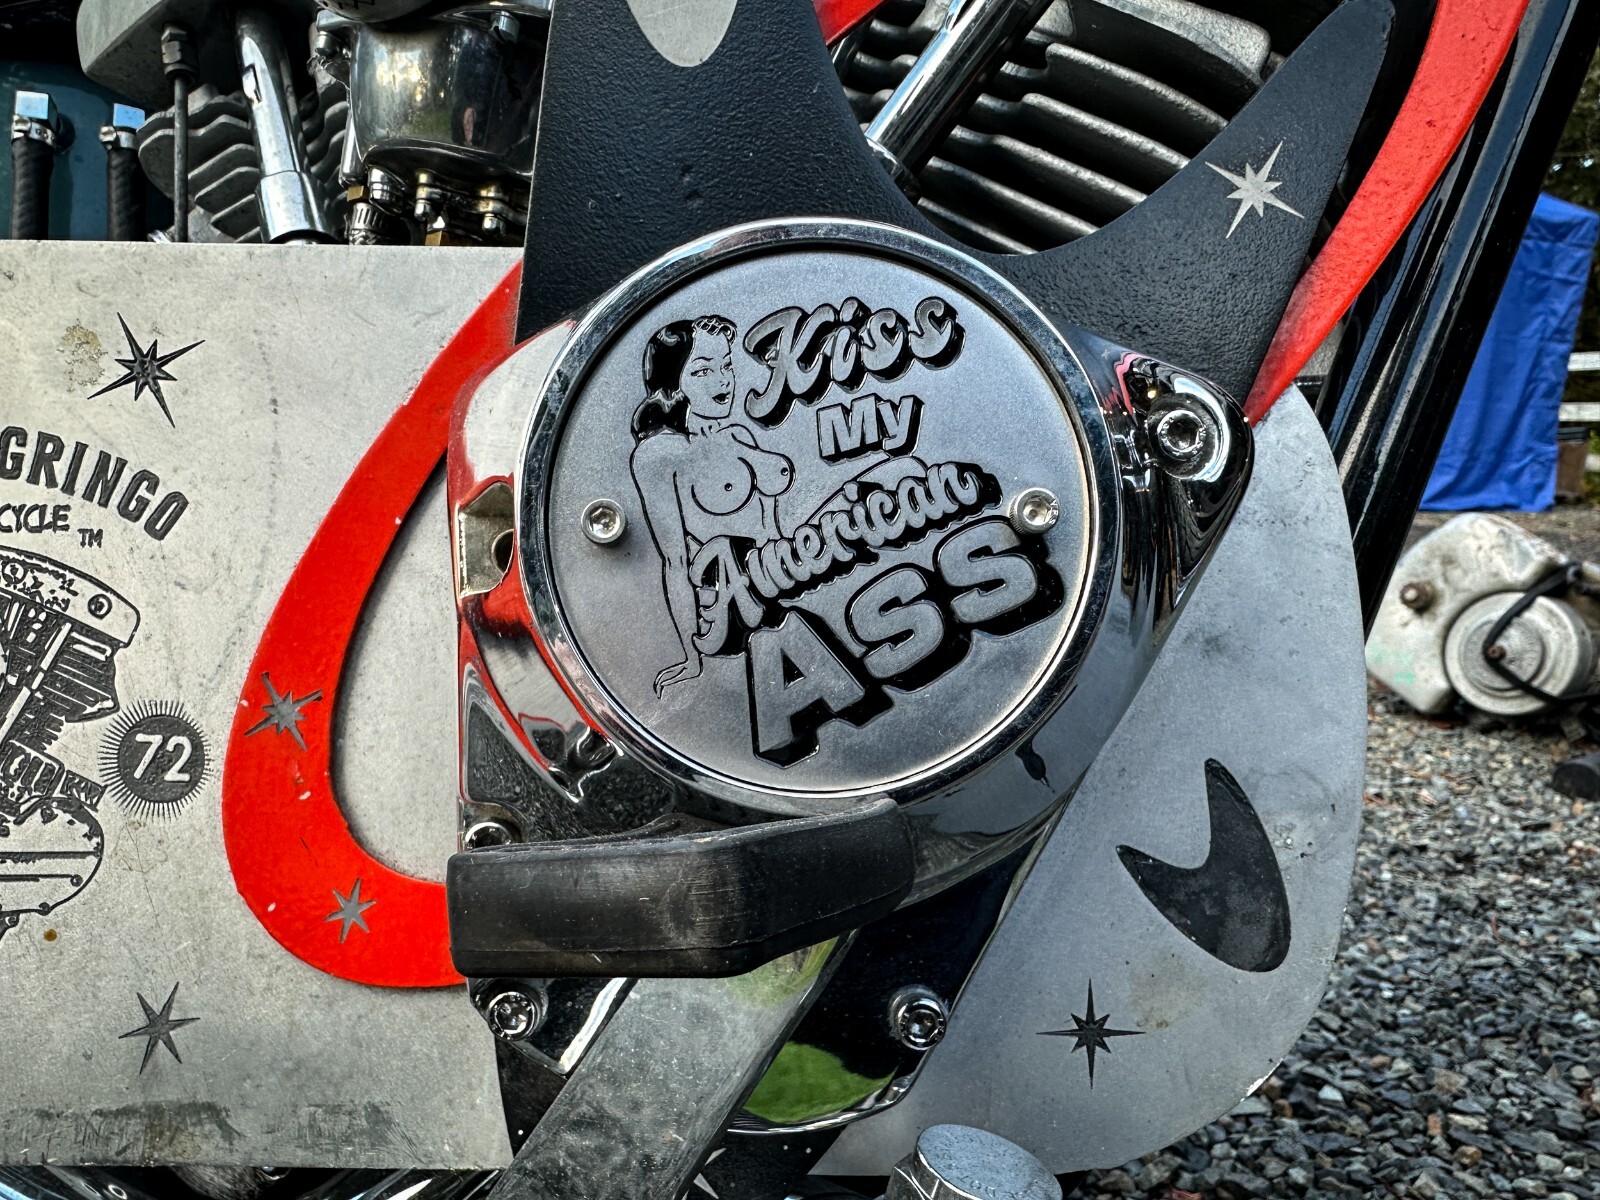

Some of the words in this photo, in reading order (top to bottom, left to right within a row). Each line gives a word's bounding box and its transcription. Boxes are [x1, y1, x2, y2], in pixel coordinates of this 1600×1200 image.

[743, 297, 966, 430] Kiss
[0, 425, 190, 541] GRINGO
[816, 393, 925, 465] My
[0, 503, 72, 533] CYCLE
[688, 455, 1003, 656] American
[747, 514, 1065, 769] ASS
[134, 733, 194, 782] 72
